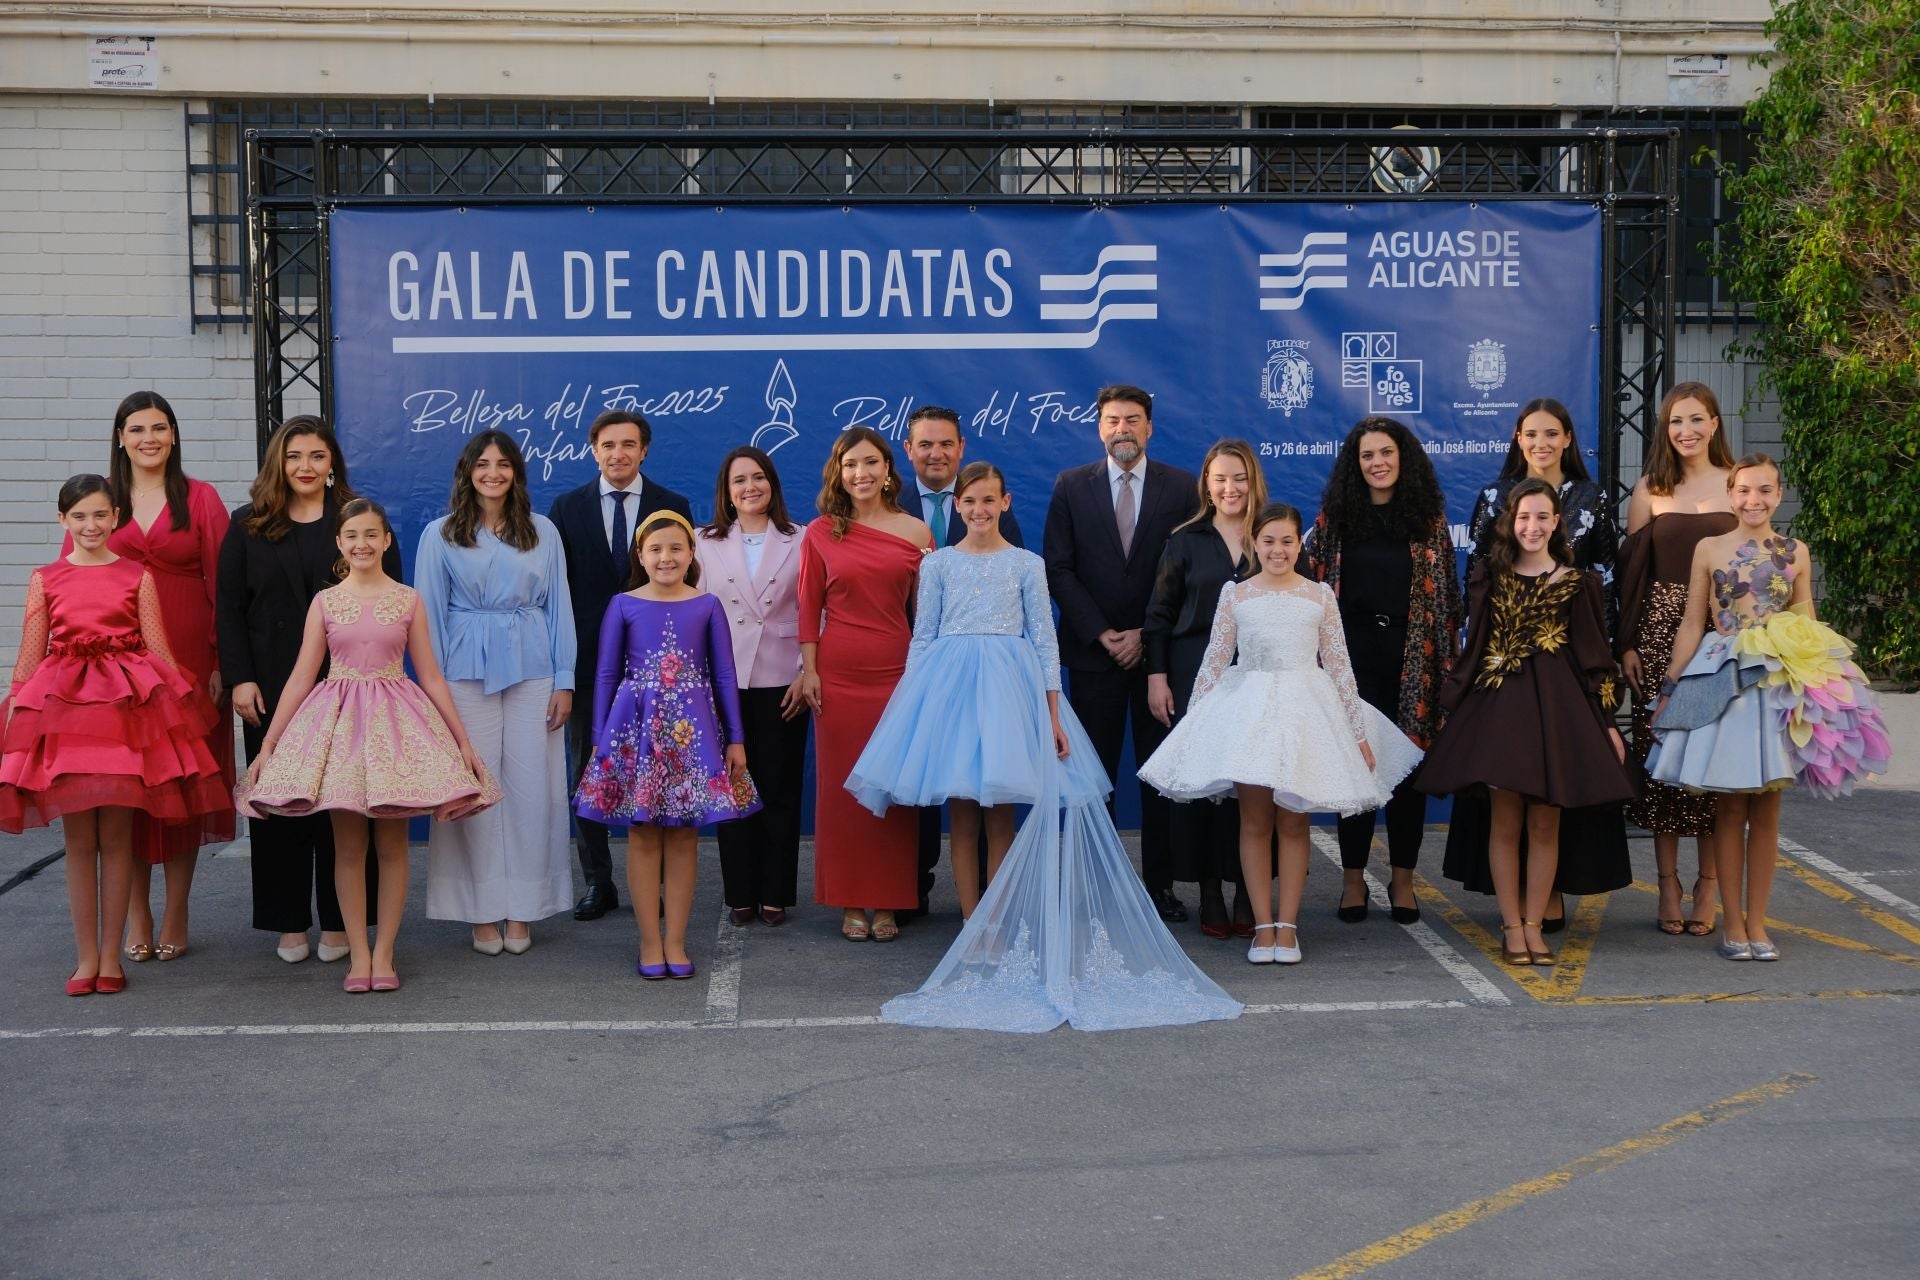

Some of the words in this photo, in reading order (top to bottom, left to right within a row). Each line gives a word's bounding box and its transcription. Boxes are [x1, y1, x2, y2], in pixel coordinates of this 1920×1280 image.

[1368, 230, 1476, 258] AGUAS
[1481, 230, 1520, 257] DE
[388, 250, 538, 321] GALA
[563, 250, 632, 320] DE
[656, 248, 1013, 320] CANDIDATAS
[1368, 260, 1520, 288] ALICANTE
[402, 389, 534, 434] Bellesa
[544, 383, 592, 430] del
[832, 396, 961, 441] Bell
[971, 389, 1019, 437] del
[516, 428, 595, 482] Infan
[1260, 442, 1273, 456] 25
[1274, 444, 1280, 459] y
[1281, 442, 1294, 456] 26
[1295, 441, 1309, 455] de
[1309, 441, 1333, 455] abril
[1442, 440, 1464, 454] José
[1465, 440, 1487, 454] Rico
[1488, 440, 1511, 454] Pére
